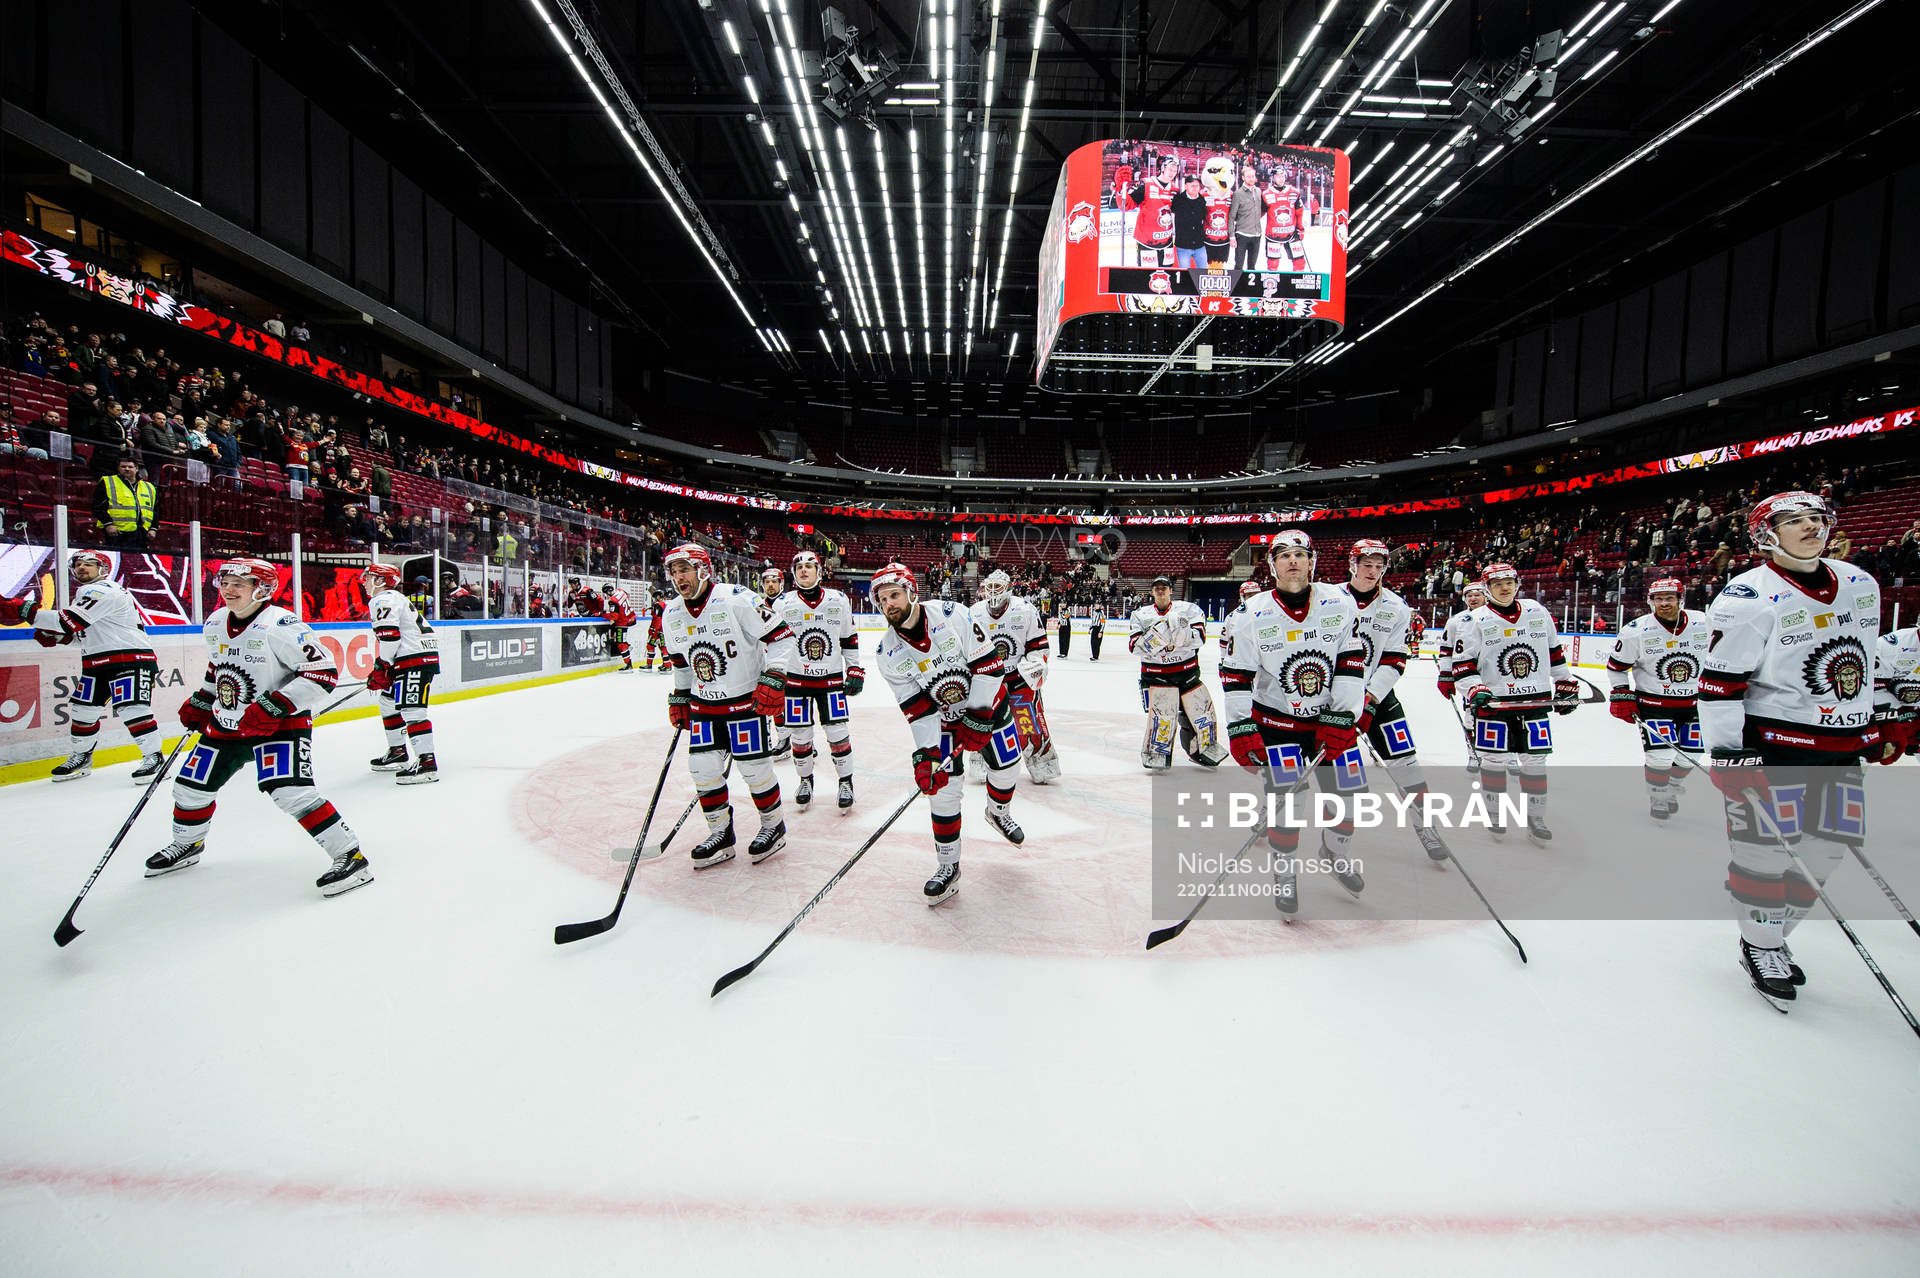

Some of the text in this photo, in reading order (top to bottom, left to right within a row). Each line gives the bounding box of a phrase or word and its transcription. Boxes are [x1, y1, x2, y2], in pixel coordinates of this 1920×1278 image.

[1201, 277, 1230, 290] 00:00
[1247, 273, 1256, 286] 2
[1208, 301, 1221, 312] VS
[1752, 410, 1917, 455] MALMÖ REDHAWKS VS
[626, 475, 740, 504] MALMÖ REDHAWKS VS FRÖLUNDA HC
[1126, 514, 1254, 525] MALMÖ REDHAWKS VS FRÖLUNDA HC
[1723, 584, 1752, 597] Ford
[77, 596, 98, 610] 31
[376, 607, 391, 621] 27
[1838, 611, 1853, 626] put
[1360, 616, 1372, 624] put
[696, 625, 708, 635] put
[1303, 629, 1318, 641] put
[1516, 628, 1526, 637] put
[470, 637, 535, 662] GUIDE
[725, 640, 738, 659] C
[1679, 640, 1690, 648] put
[227, 647, 240, 657] put
[932, 654, 944, 670] put
[1162, 655, 1183, 664] RASTA
[803, 668, 829, 676] RASTA
[976, 664, 998, 674] morris
[303, 671, 329, 682] morris
[1508, 685, 1537, 695] RASTA
[1663, 688, 1694, 696] RASTA
[1704, 682, 1724, 693] law.
[700, 690, 728, 700] RASTA
[944, 708, 967, 720] RAS
[1293, 703, 1331, 716] RASTA
[1819, 713, 1870, 726] RASTA
